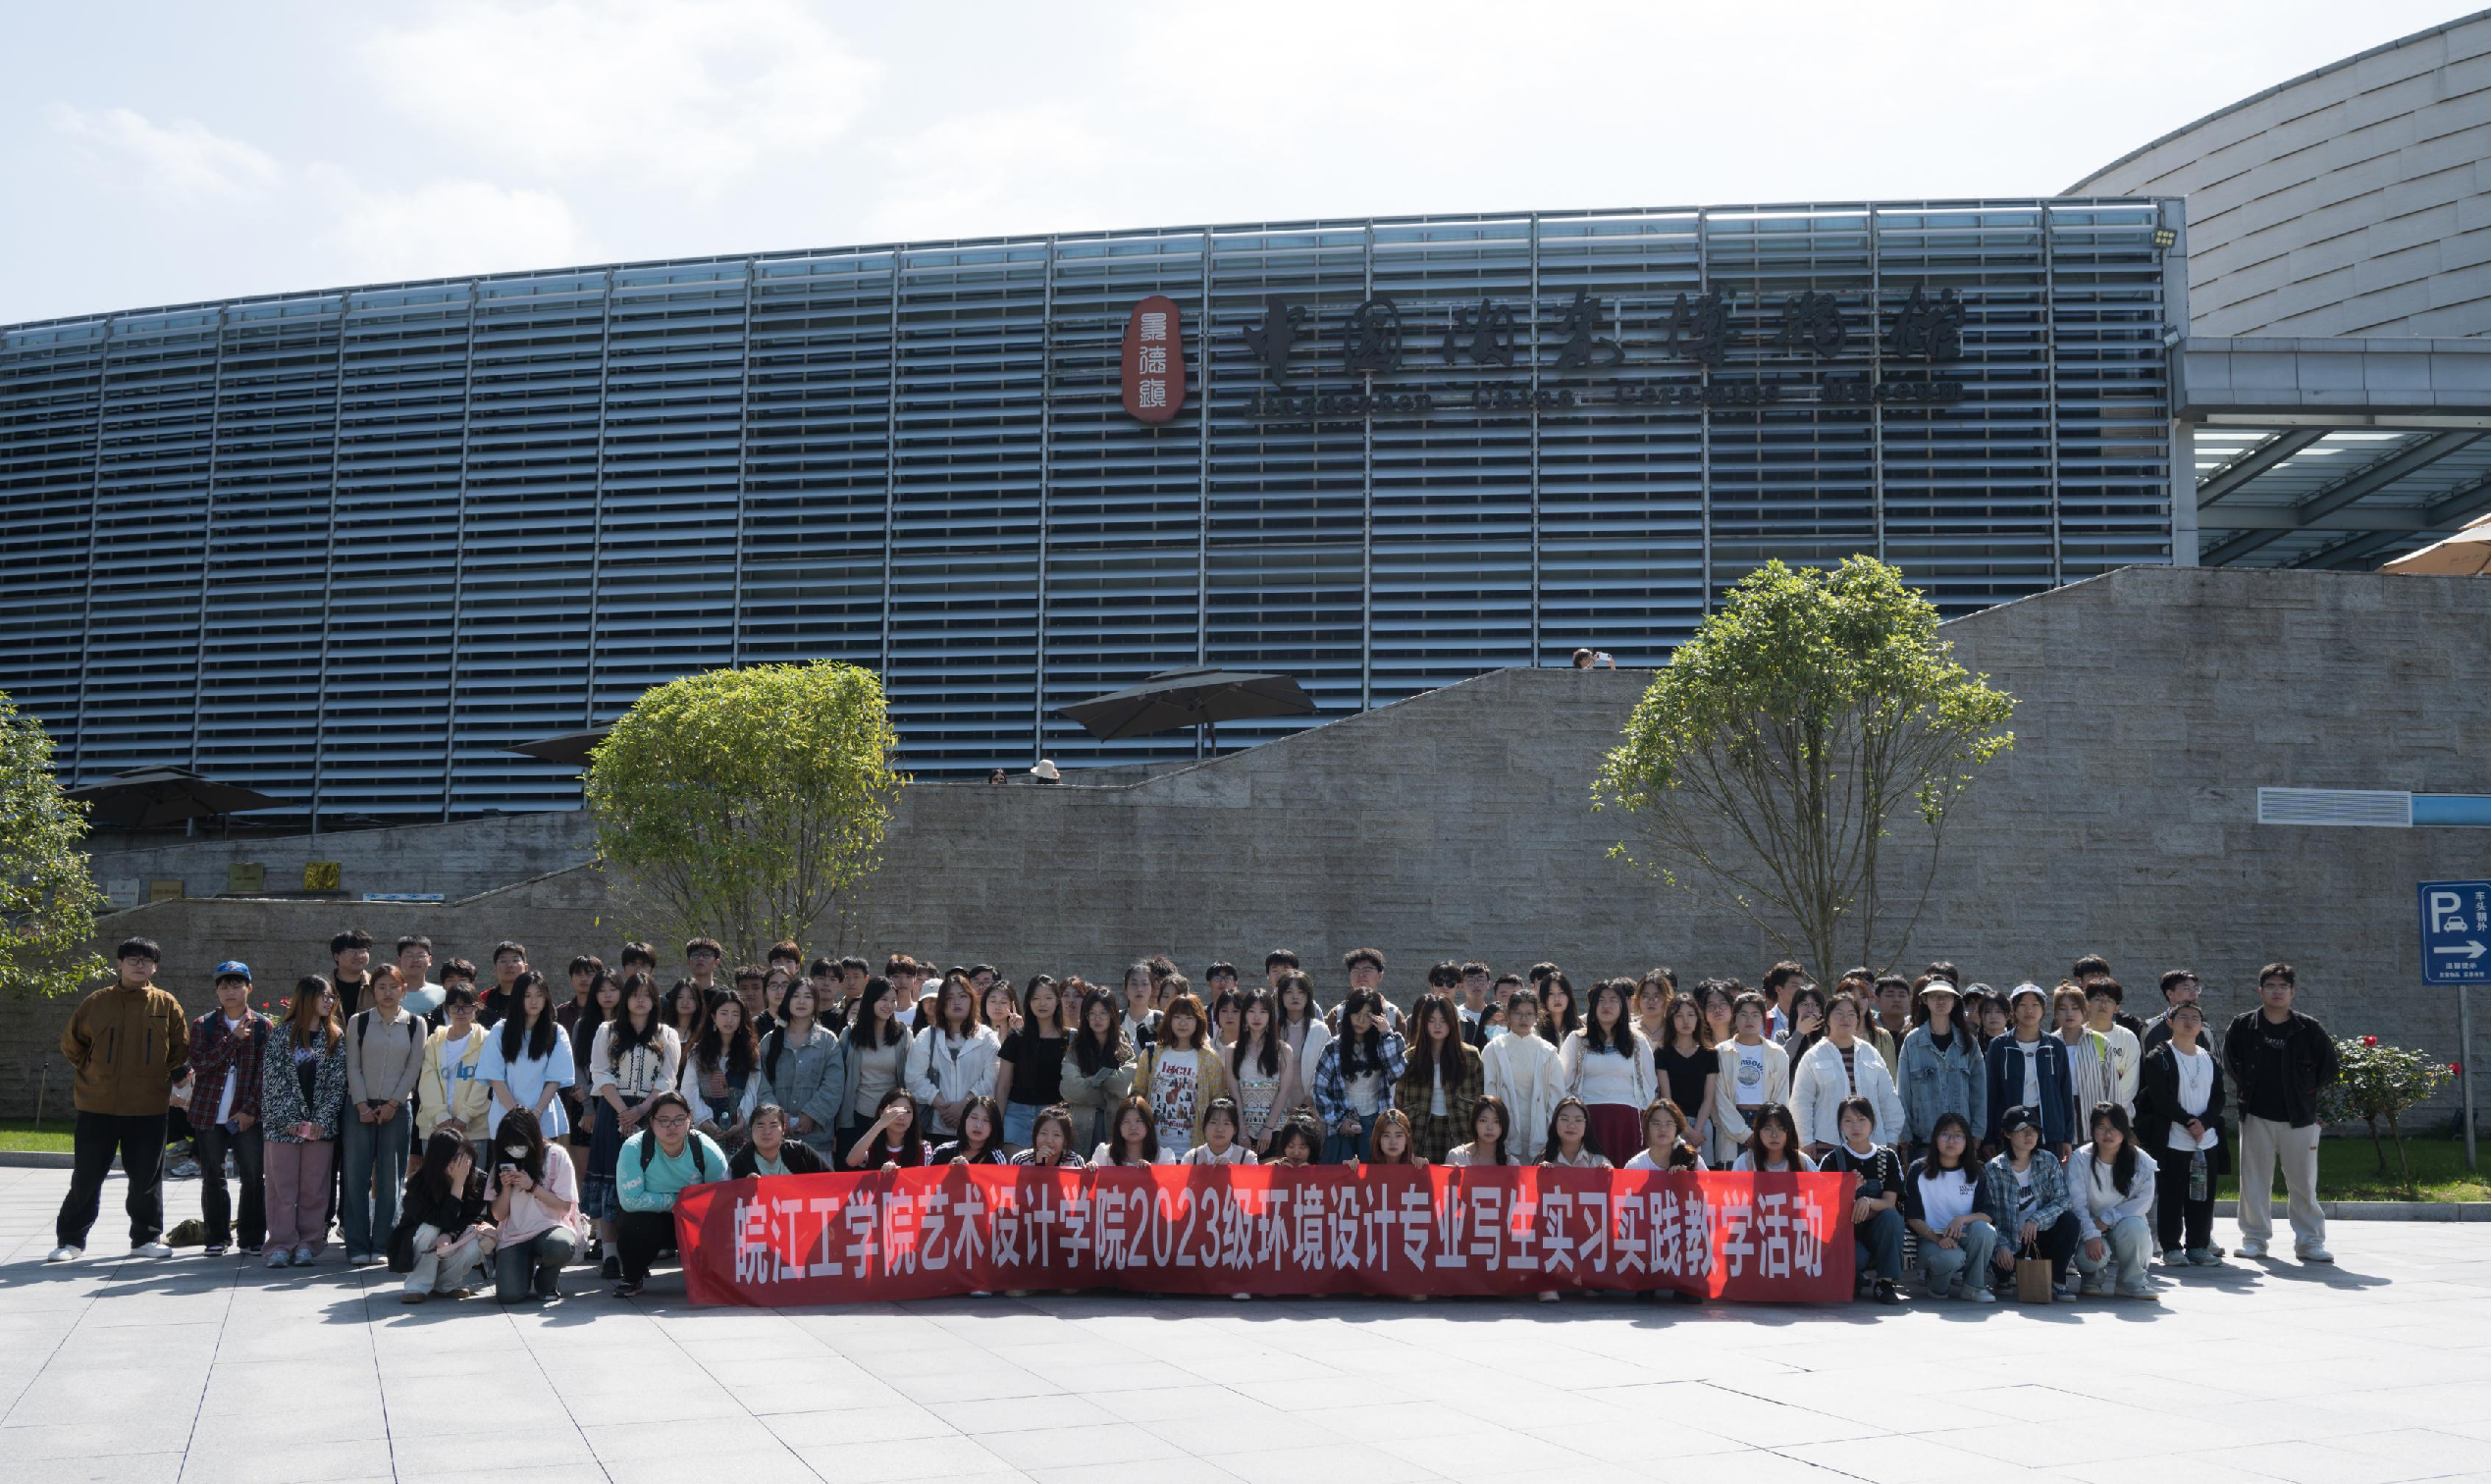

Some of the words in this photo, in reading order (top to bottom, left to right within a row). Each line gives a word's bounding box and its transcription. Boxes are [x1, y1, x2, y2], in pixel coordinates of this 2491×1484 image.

[1243, 392, 1432, 418] Jingdezhen
[1472, 387, 1577, 411] China
[1616, 379, 1780, 405] Ceramics
[1824, 377, 1965, 402] Museum
[2431, 891, 2462, 933] P
[2474, 891, 2488, 932] 车头朝外
[734, 1183, 1824, 1285] 皖江工学院艺术设计学院2023级环境设计专业写生实习实践教学活动
